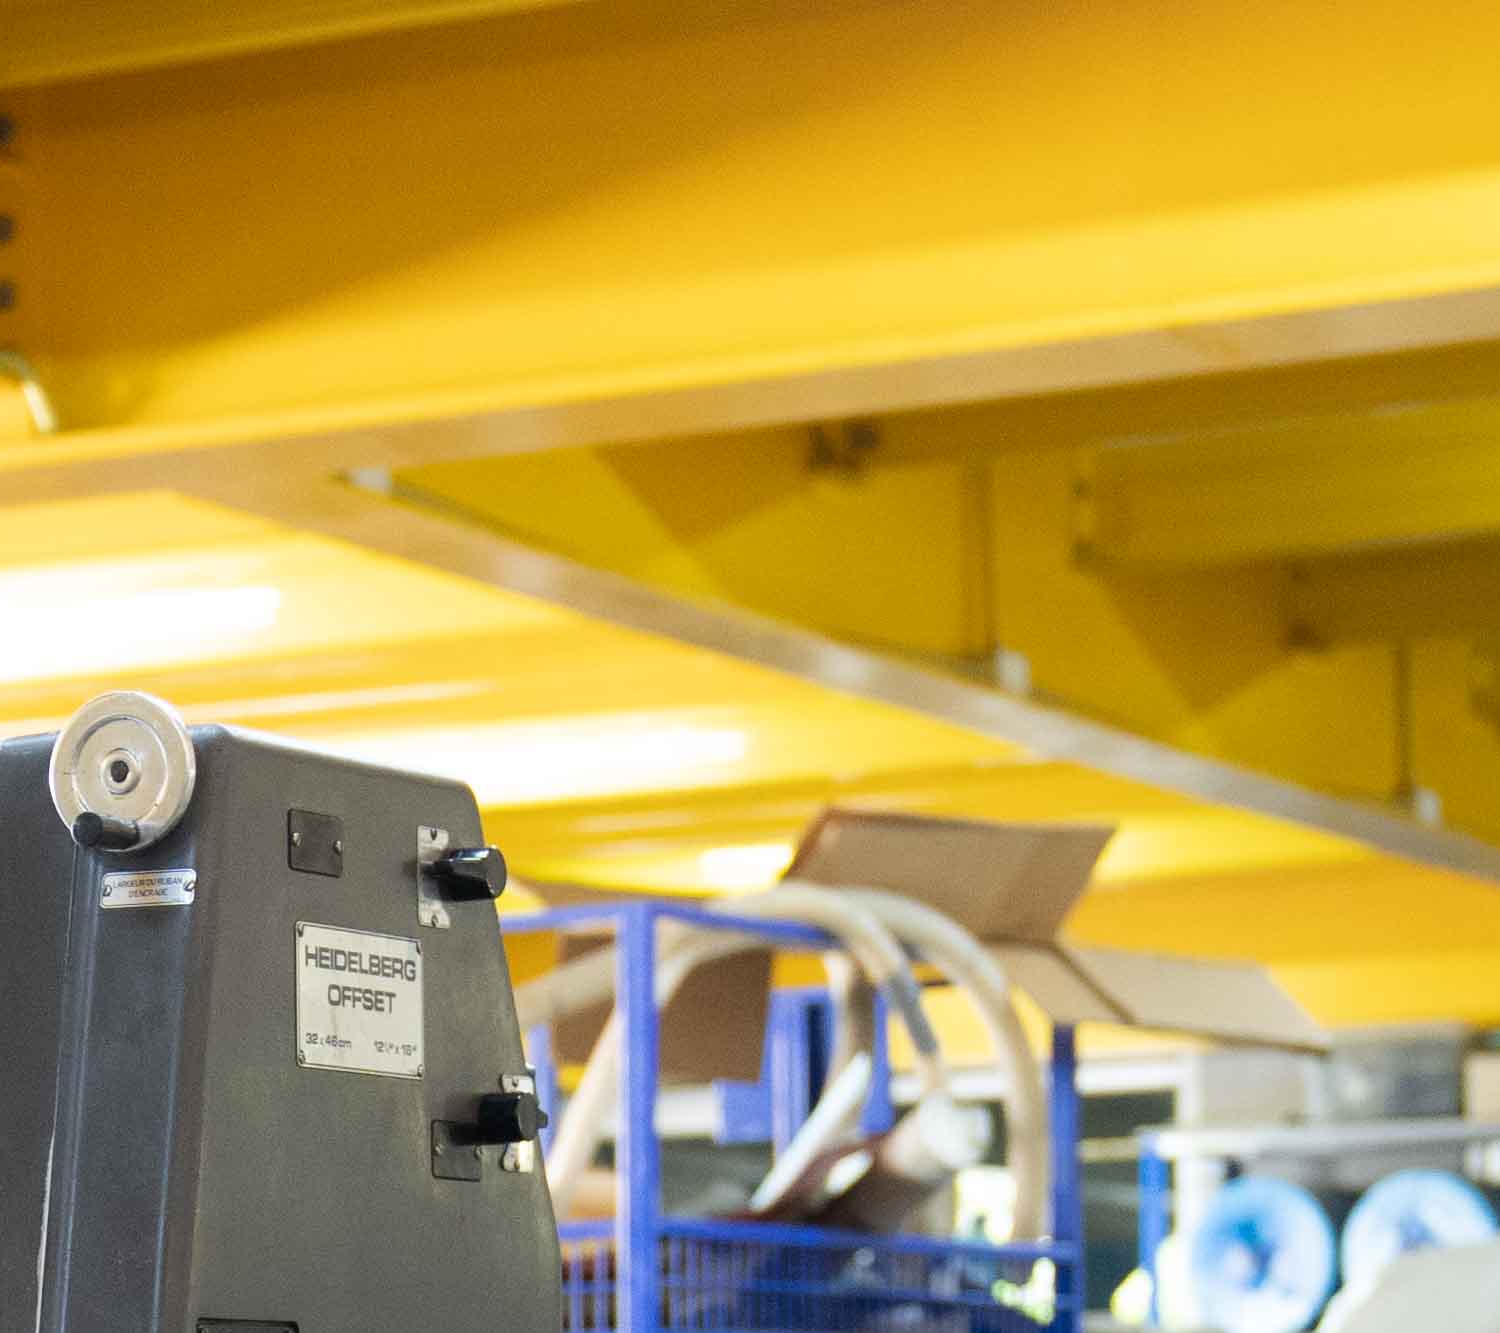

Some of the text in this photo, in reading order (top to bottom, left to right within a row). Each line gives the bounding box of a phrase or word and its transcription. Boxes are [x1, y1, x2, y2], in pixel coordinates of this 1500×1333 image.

[305, 945, 416, 981] HEIDELBERG
[328, 984, 396, 1014] OFFSET
[305, 1033, 318, 1044] 32
